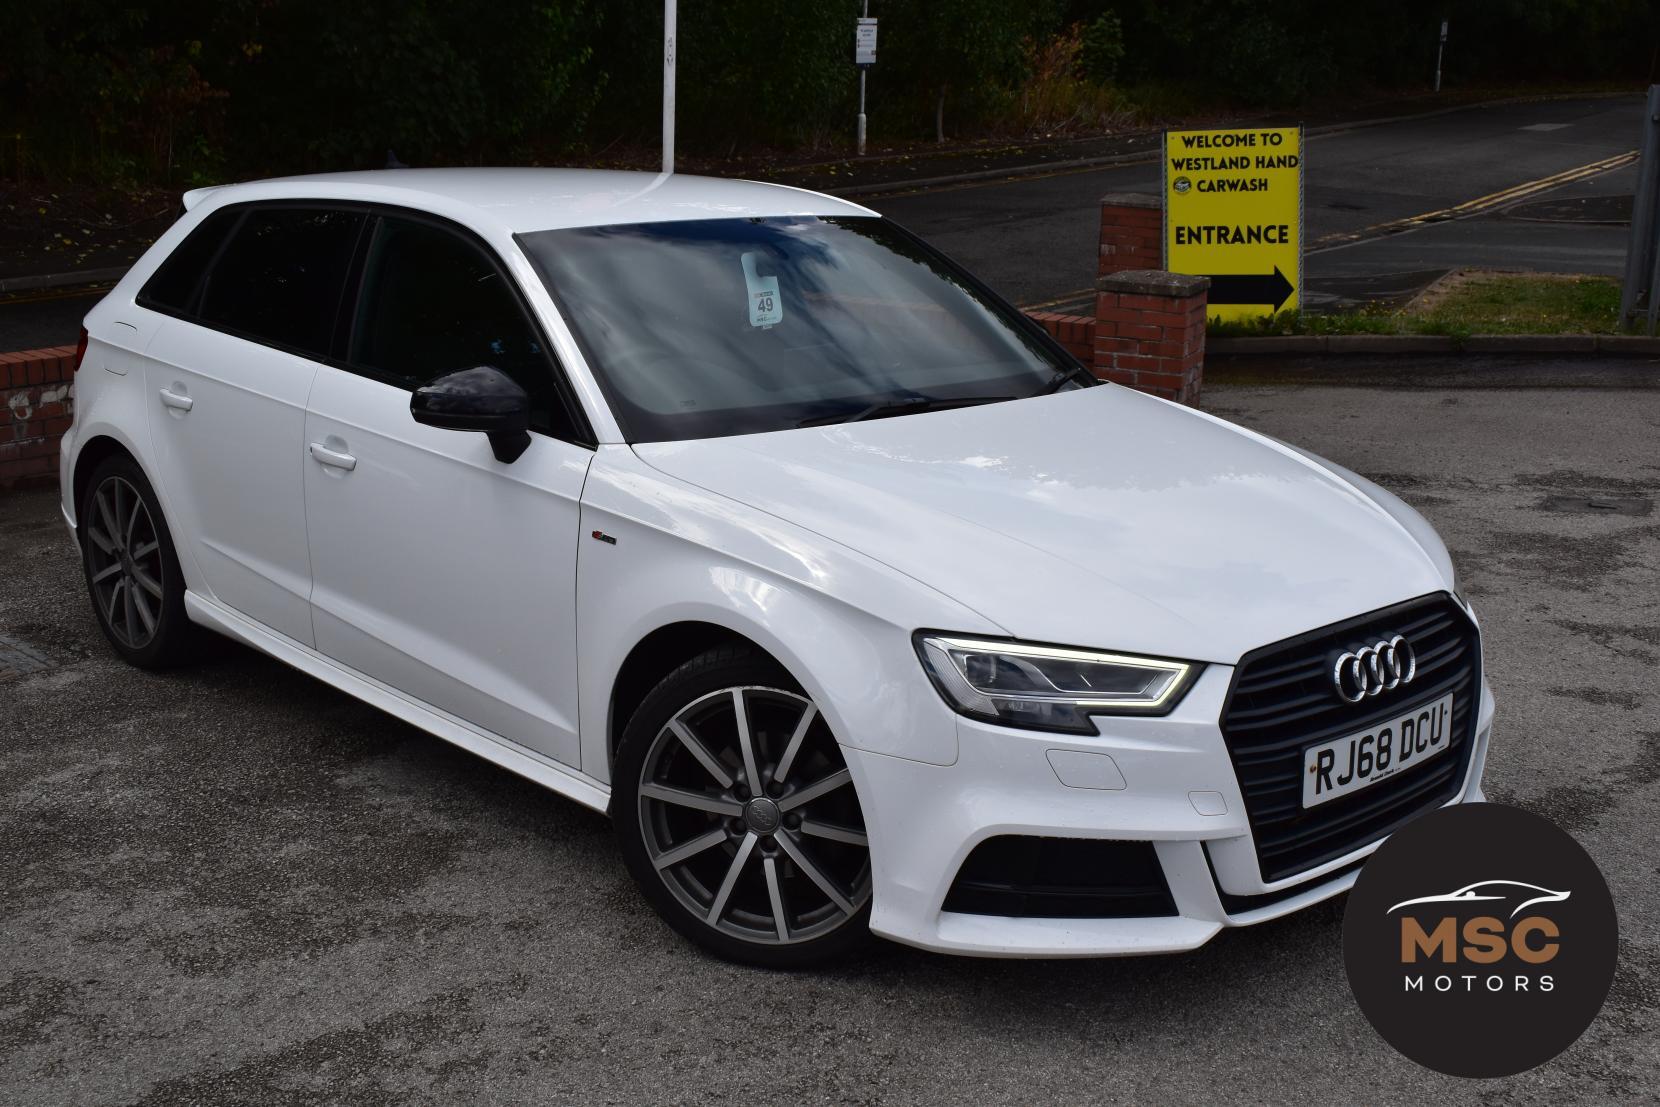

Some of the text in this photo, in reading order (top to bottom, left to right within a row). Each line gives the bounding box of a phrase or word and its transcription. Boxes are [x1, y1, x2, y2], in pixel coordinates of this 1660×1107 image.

[1182, 132, 1283, 148] WELCOME TO
[1171, 155, 1298, 171] WESTLAND HAND
[1197, 178, 1268, 192] CARWASH
[1175, 225, 1289, 245] ENTRANCE
[758, 297, 773, 312] 49
[1315, 702, 1444, 795] RJ68 DCU
